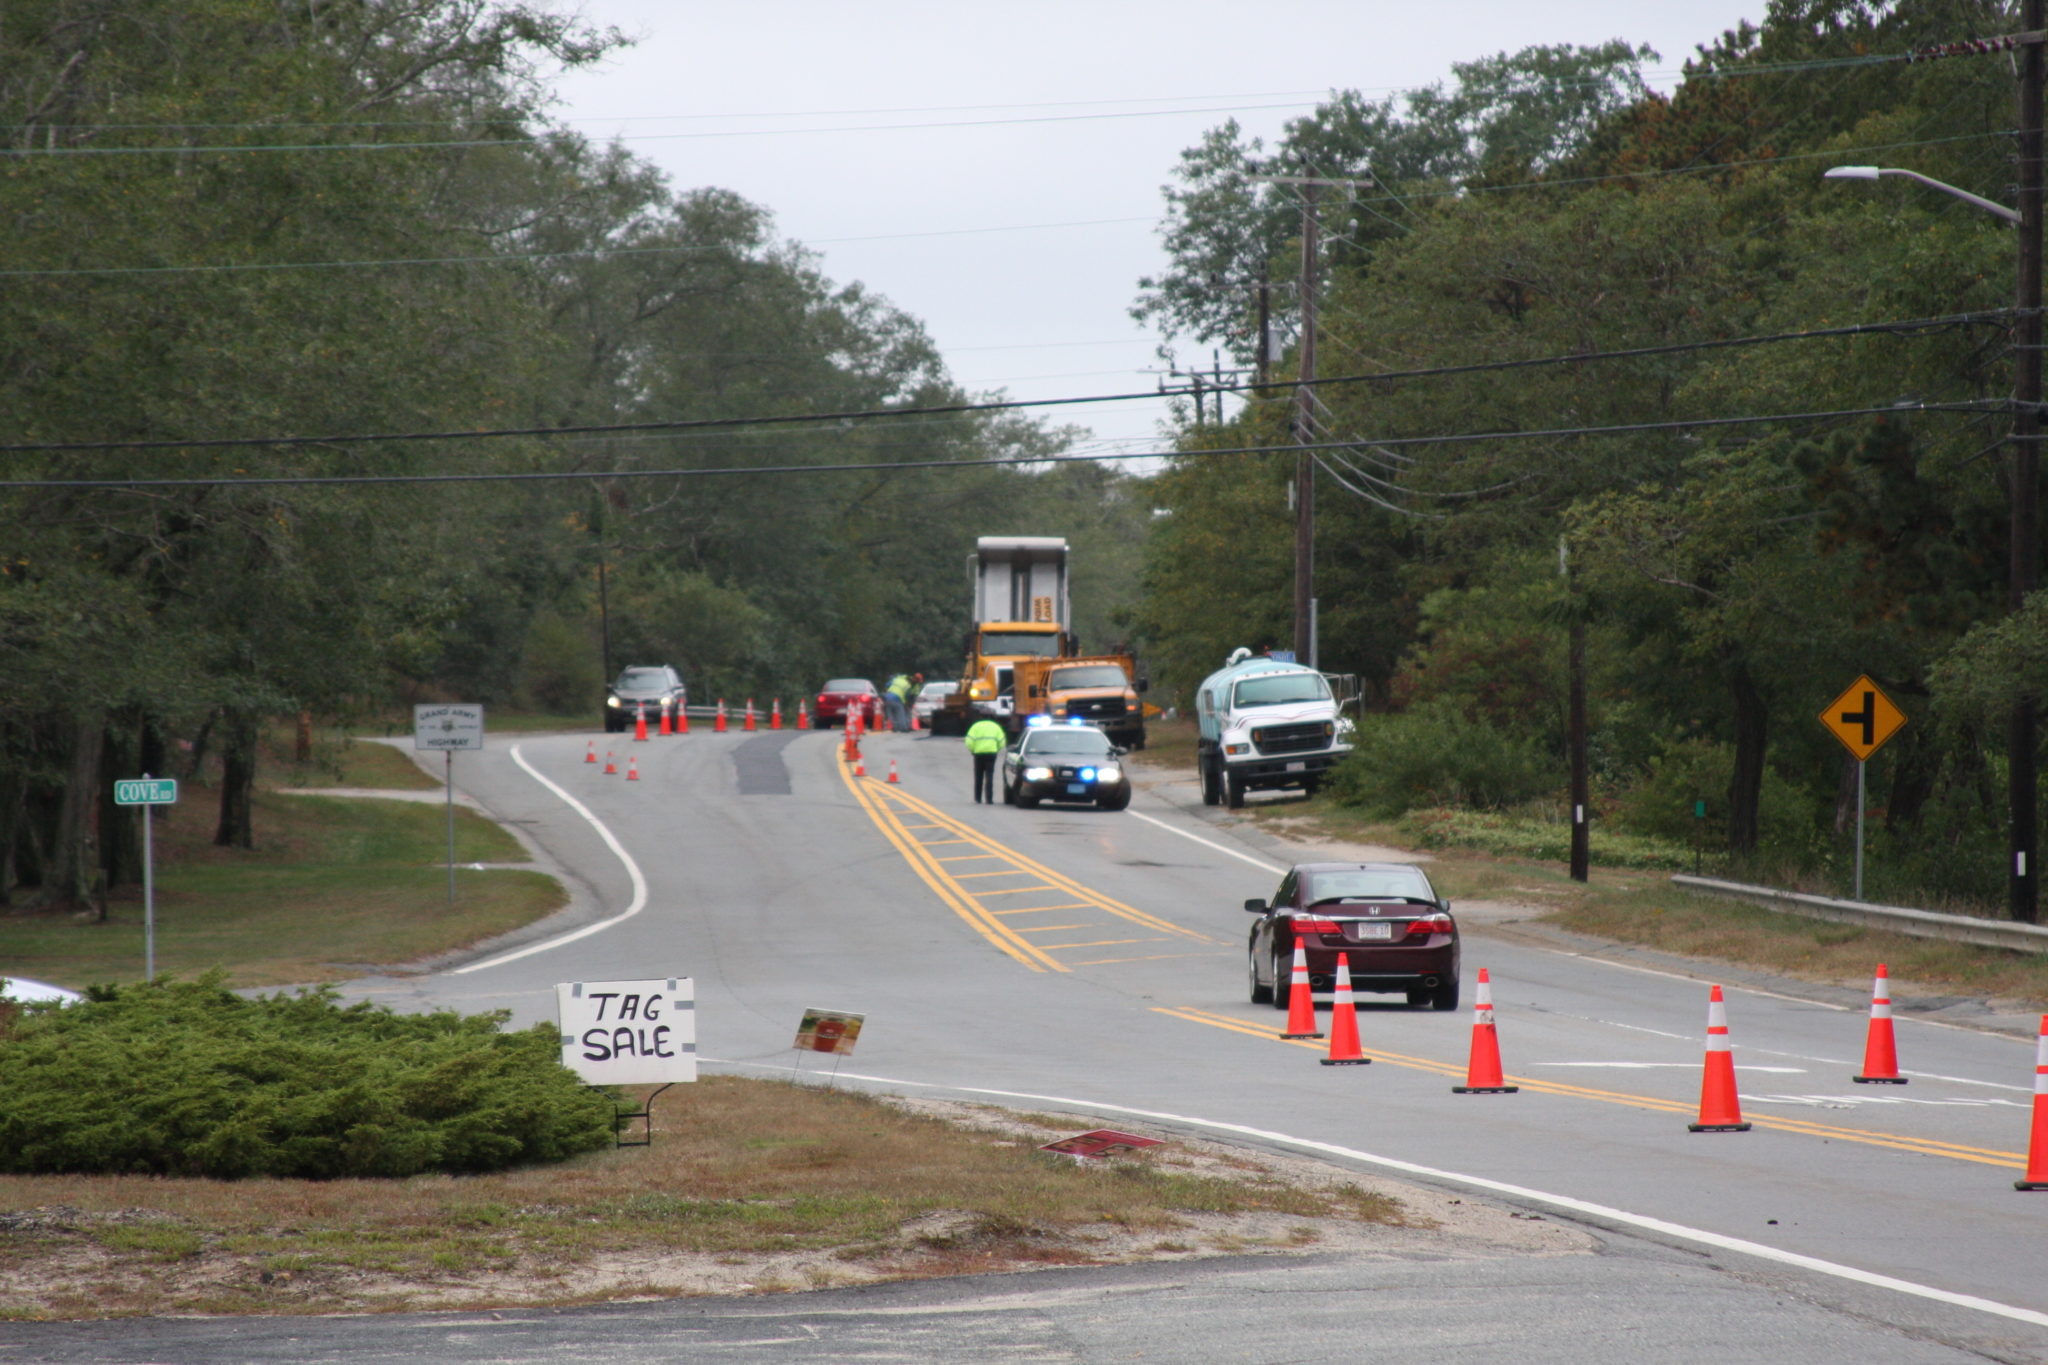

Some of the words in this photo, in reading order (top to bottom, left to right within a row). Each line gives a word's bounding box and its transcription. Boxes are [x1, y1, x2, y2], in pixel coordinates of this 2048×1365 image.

[420, 709, 449, 720] GRAND
[452, 709, 477, 719] ARMY
[427, 738, 469, 746] HIGHWAY
[120, 783, 159, 801] COVE
[589, 993, 663, 1021] TAG
[582, 1025, 675, 1061] SALE
